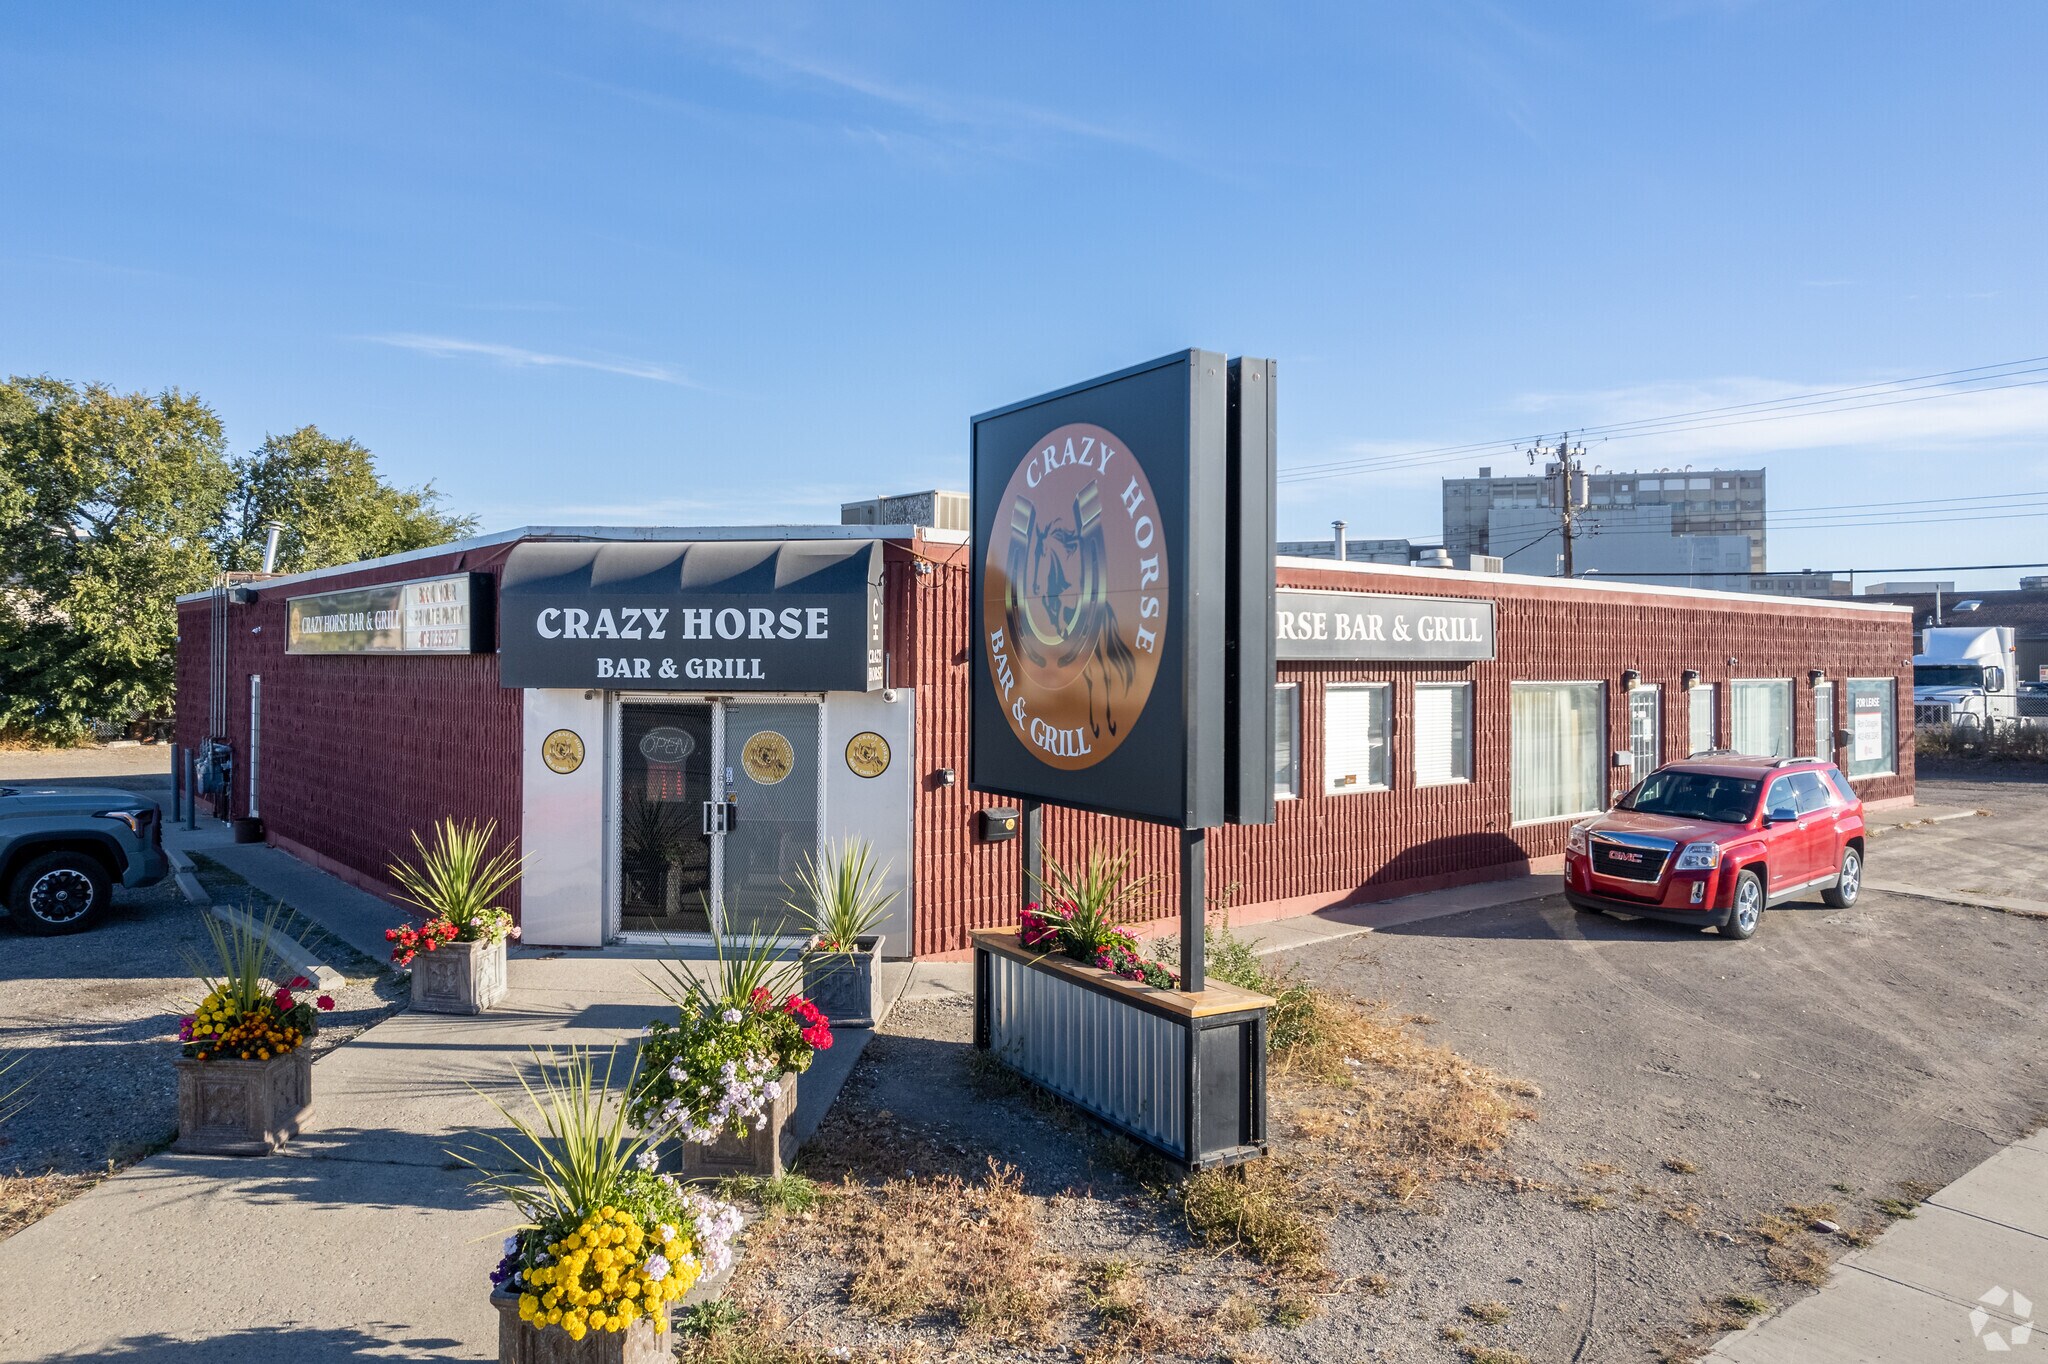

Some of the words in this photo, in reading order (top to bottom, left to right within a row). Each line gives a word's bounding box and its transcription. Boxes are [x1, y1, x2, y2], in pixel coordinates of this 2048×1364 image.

[1026, 437, 1115, 488] CRAZY
[1120, 475, 1160, 654] HORSE
[301, 615, 323, 634] CRAZY
[323, 613, 348, 633] HORSE
[349, 612, 365, 632] BAR
[366, 611, 374, 631] &
[374, 609, 401, 631] GRILL
[536, 608, 669, 640] CRAZY
[682, 607, 829, 640] HORSE
[1334, 613, 1386, 641] BAR
[1392, 615, 1413, 642] &
[1418, 615, 1484, 643] GRILL
[596, 658, 651, 680] BAR
[658, 658, 680, 679] &
[684, 658, 766, 680] GRILL
[991, 626, 1015, 702] BAR
[1012, 697, 1028, 731] &
[1030, 717, 1092, 757] GRILL
[1856, 698, 1866, 708] FOR
[1866, 697, 1881, 707] LEASE
[643, 736, 688, 754] OPEN
[1609, 850, 1643, 863] GMC
